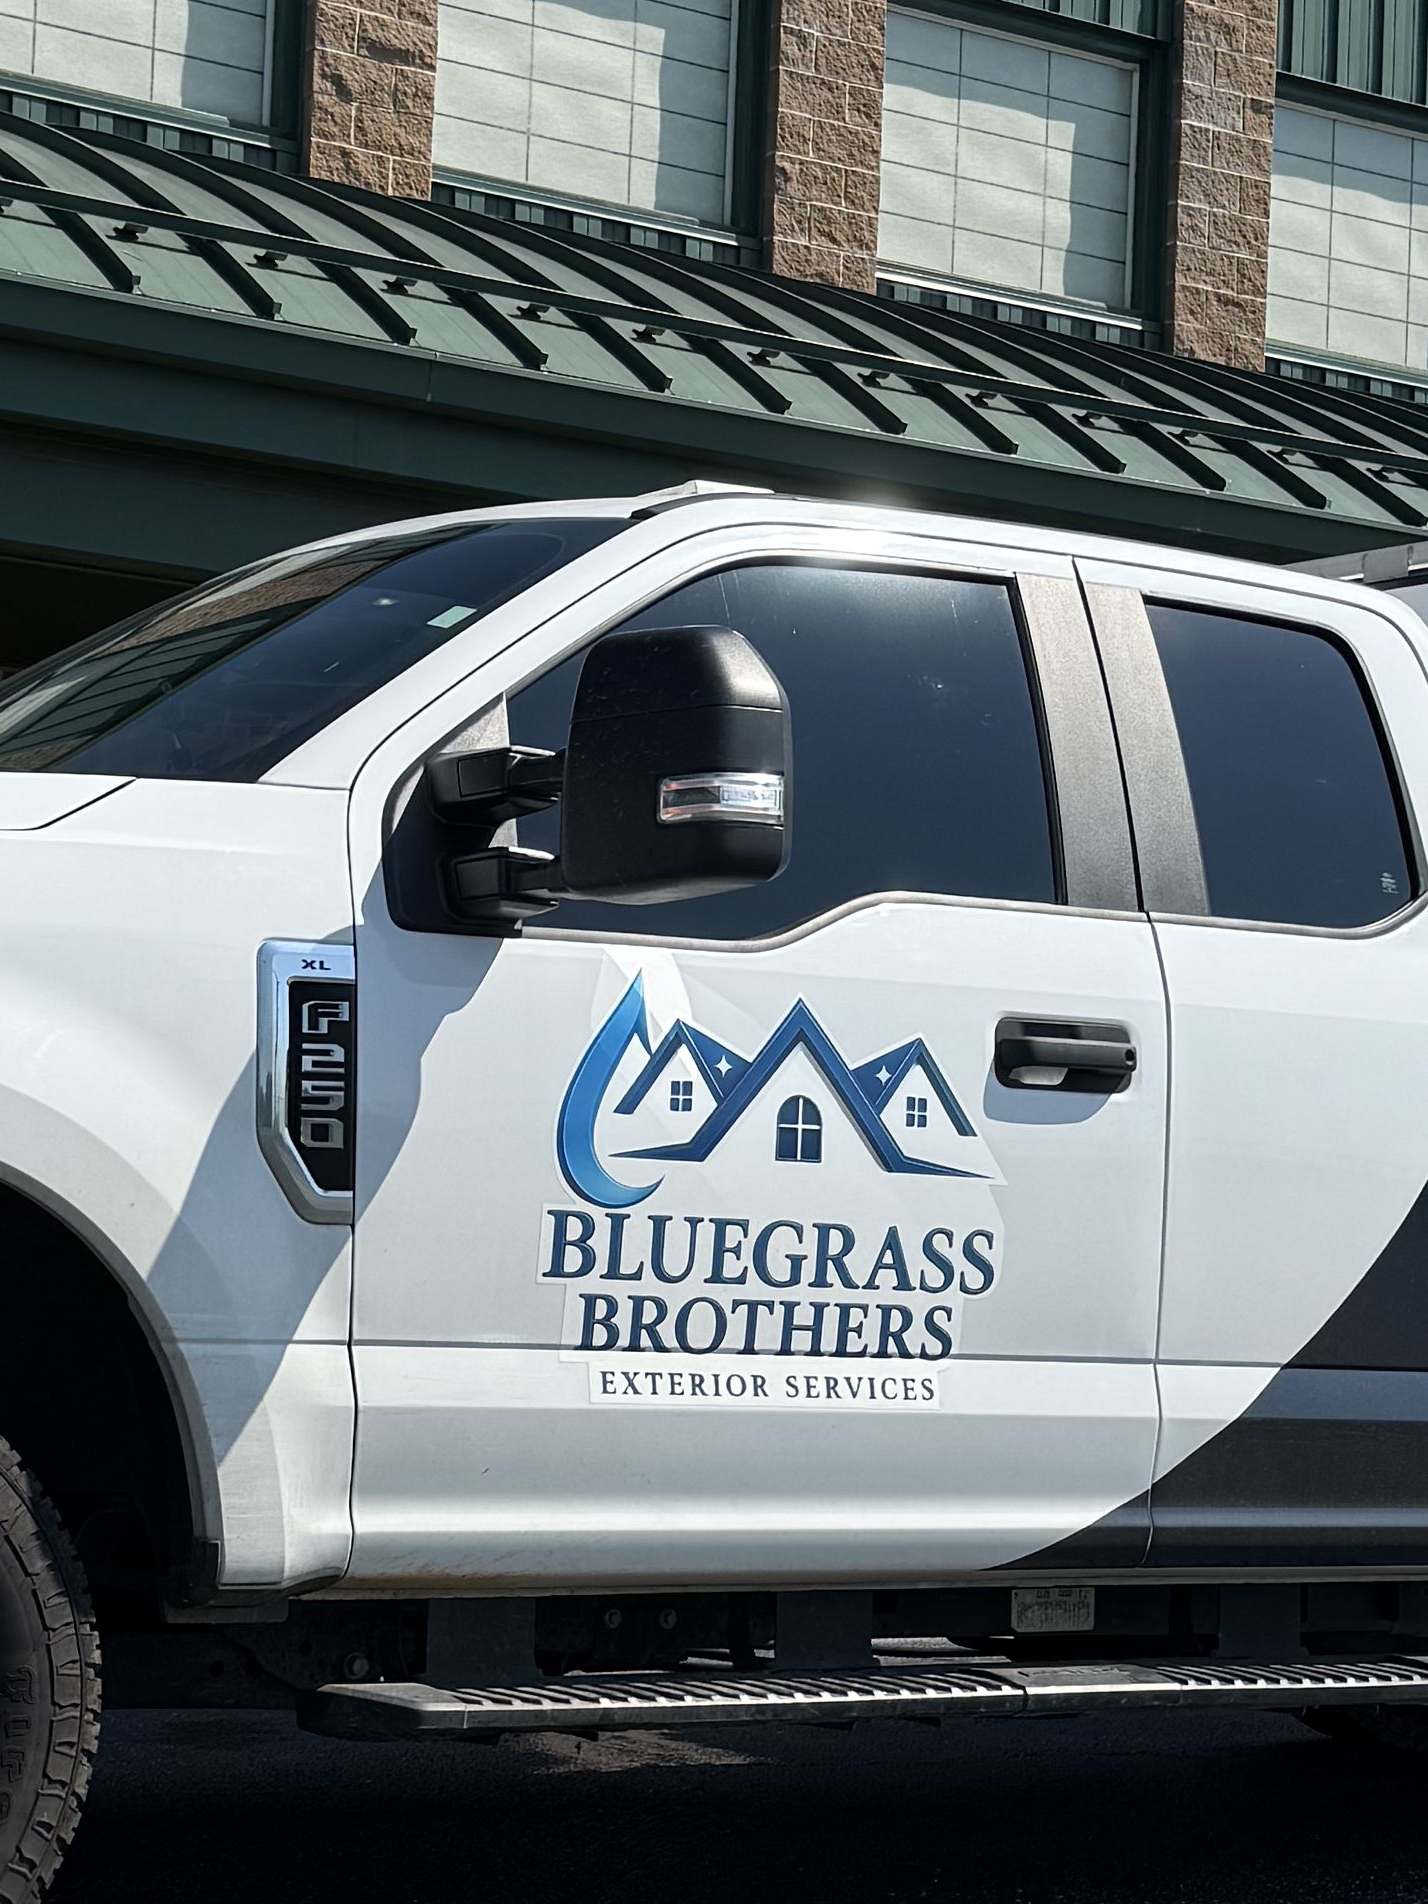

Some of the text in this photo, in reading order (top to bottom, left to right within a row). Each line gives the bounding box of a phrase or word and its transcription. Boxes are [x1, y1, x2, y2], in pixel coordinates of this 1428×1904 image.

[301, 958, 331, 971] XL
[299, 1000, 350, 1149] F250
[541, 1208, 996, 1296] BLUEGRASS
[573, 1292, 954, 1361] BROTHERS
[599, 1370, 936, 1402] EXTERIOR SERVICES
